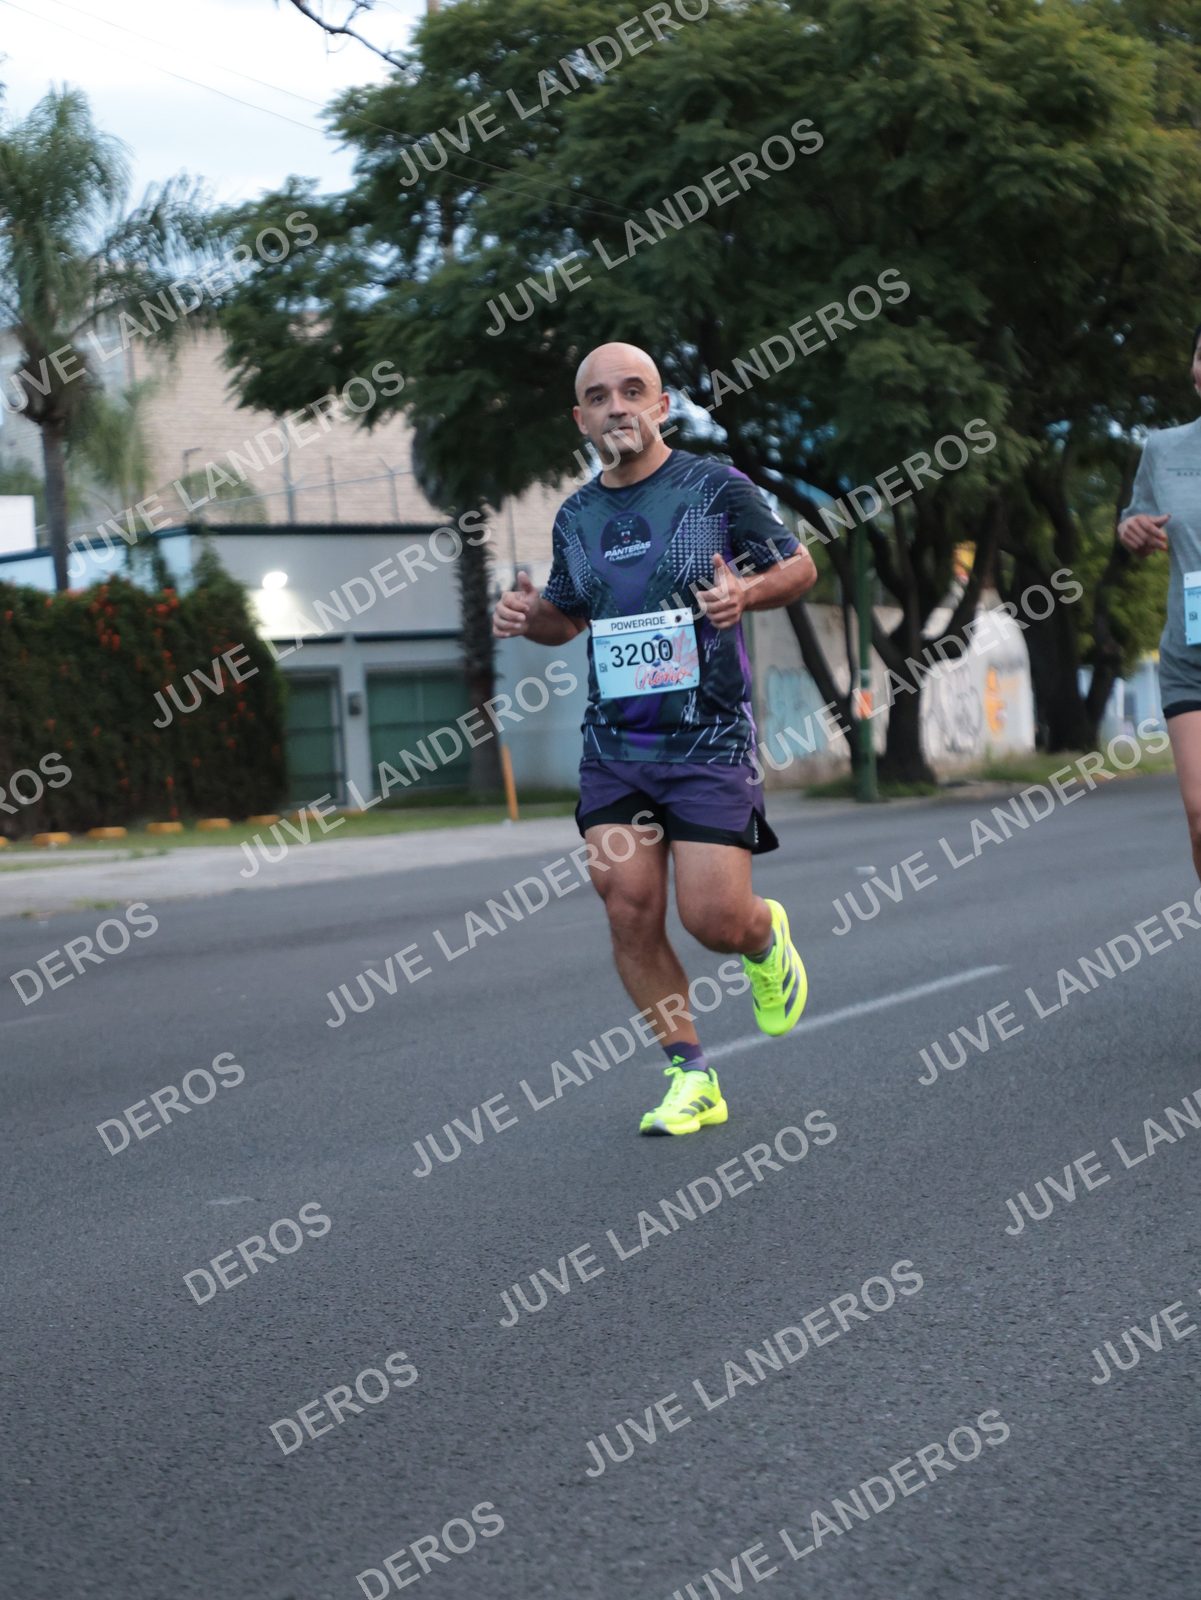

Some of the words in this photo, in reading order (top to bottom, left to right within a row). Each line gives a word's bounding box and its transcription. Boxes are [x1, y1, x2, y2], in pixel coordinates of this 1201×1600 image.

[604, 541, 651, 558] PANTERAS
[611, 616, 667, 631] POWERADE
[610, 639, 673, 668] 3200
